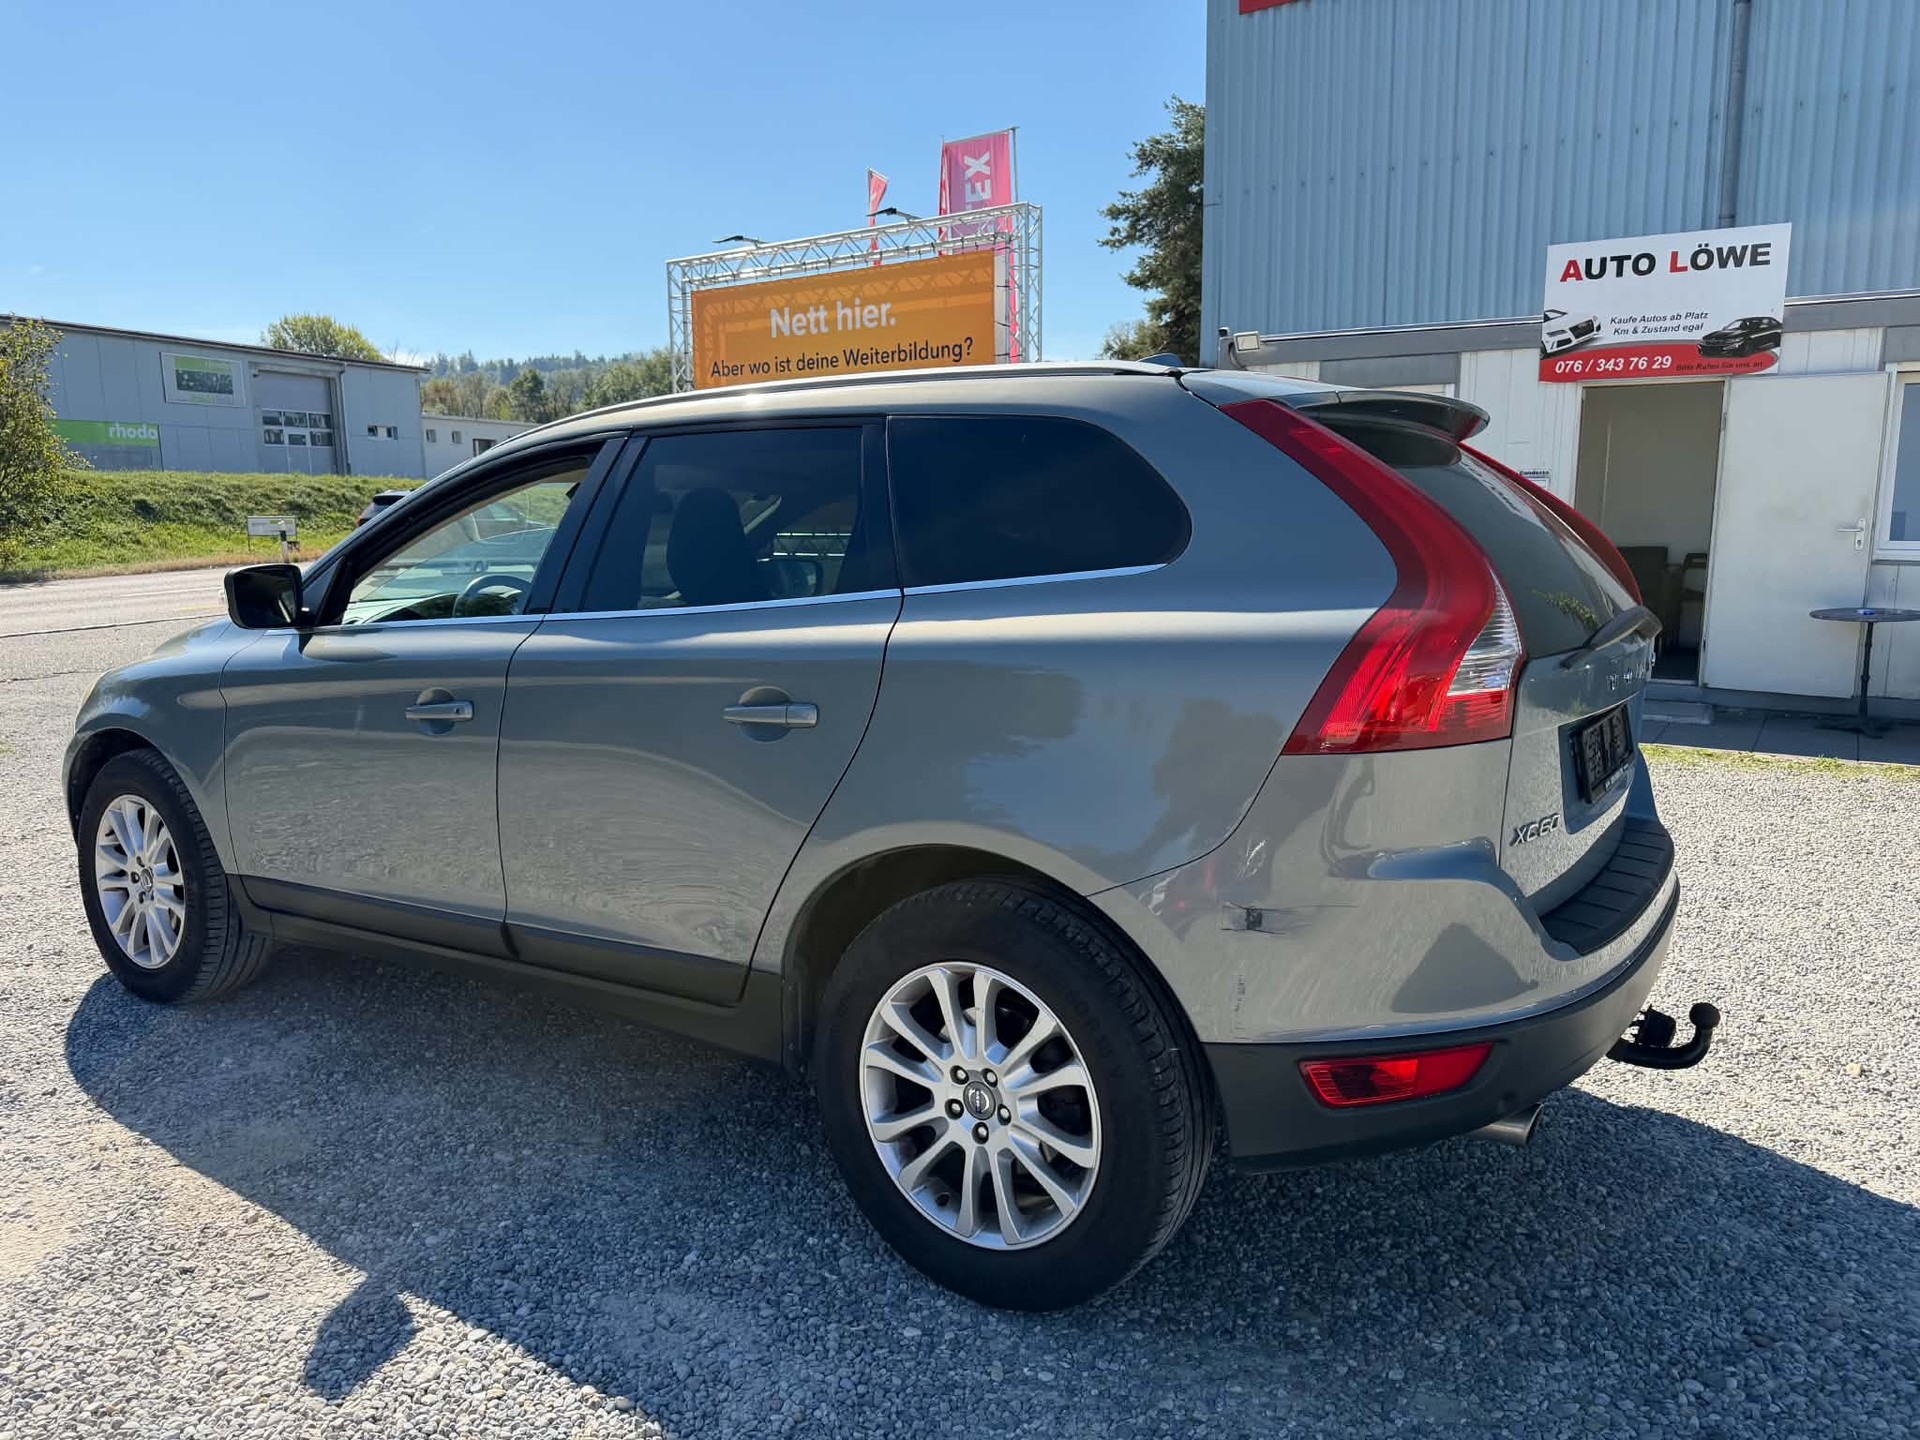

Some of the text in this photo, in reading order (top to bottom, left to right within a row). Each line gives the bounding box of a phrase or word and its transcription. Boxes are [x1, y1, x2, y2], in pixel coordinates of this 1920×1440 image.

[1560, 242, 1772, 283] AUTO LÖWE
[770, 298, 896, 338] Nett hier.
[1610, 311, 1710, 325] Kaufe Autos ab Platz
[1613, 322, 1704, 336] Km & Zustand egal
[711, 336, 974, 378] Aber wo ist deine Weiterbildung?
[1555, 359, 1583, 374] 076
[1596, 358, 1624, 372] 343
[1629, 357, 1647, 370] 76
[1651, 355, 1672, 369] 29
[108, 422, 158, 440] rhoda
